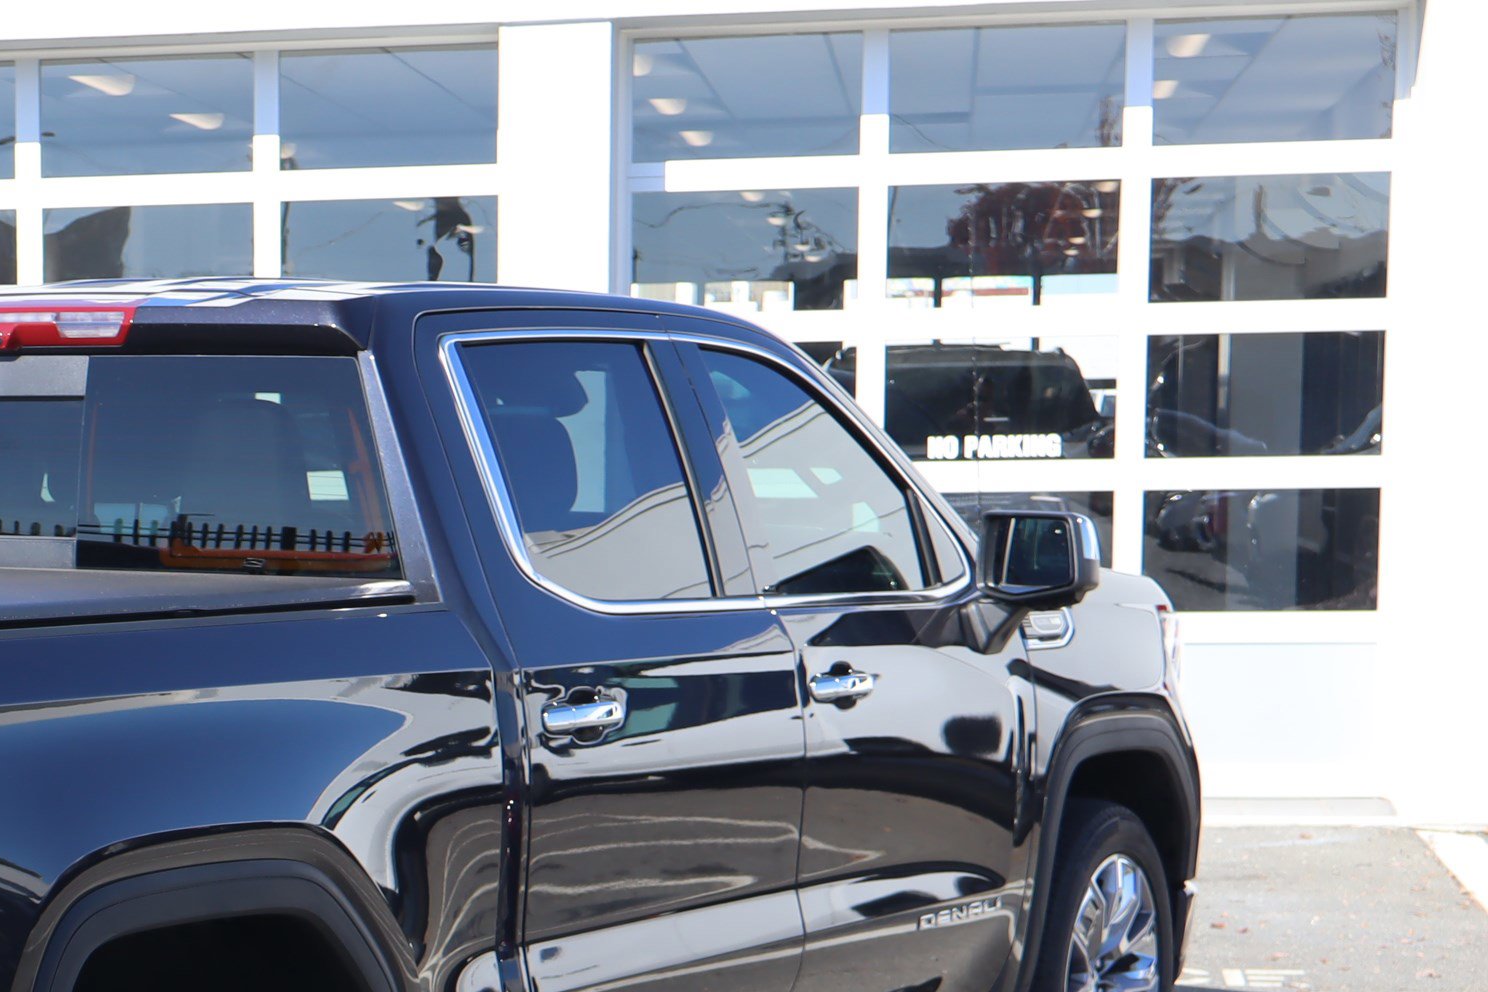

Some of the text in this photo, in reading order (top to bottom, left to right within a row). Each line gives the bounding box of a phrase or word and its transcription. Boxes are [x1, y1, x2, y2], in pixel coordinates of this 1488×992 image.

[926, 433, 1062, 460] NO PARKING
[917, 896, 1002, 929] DENALI
